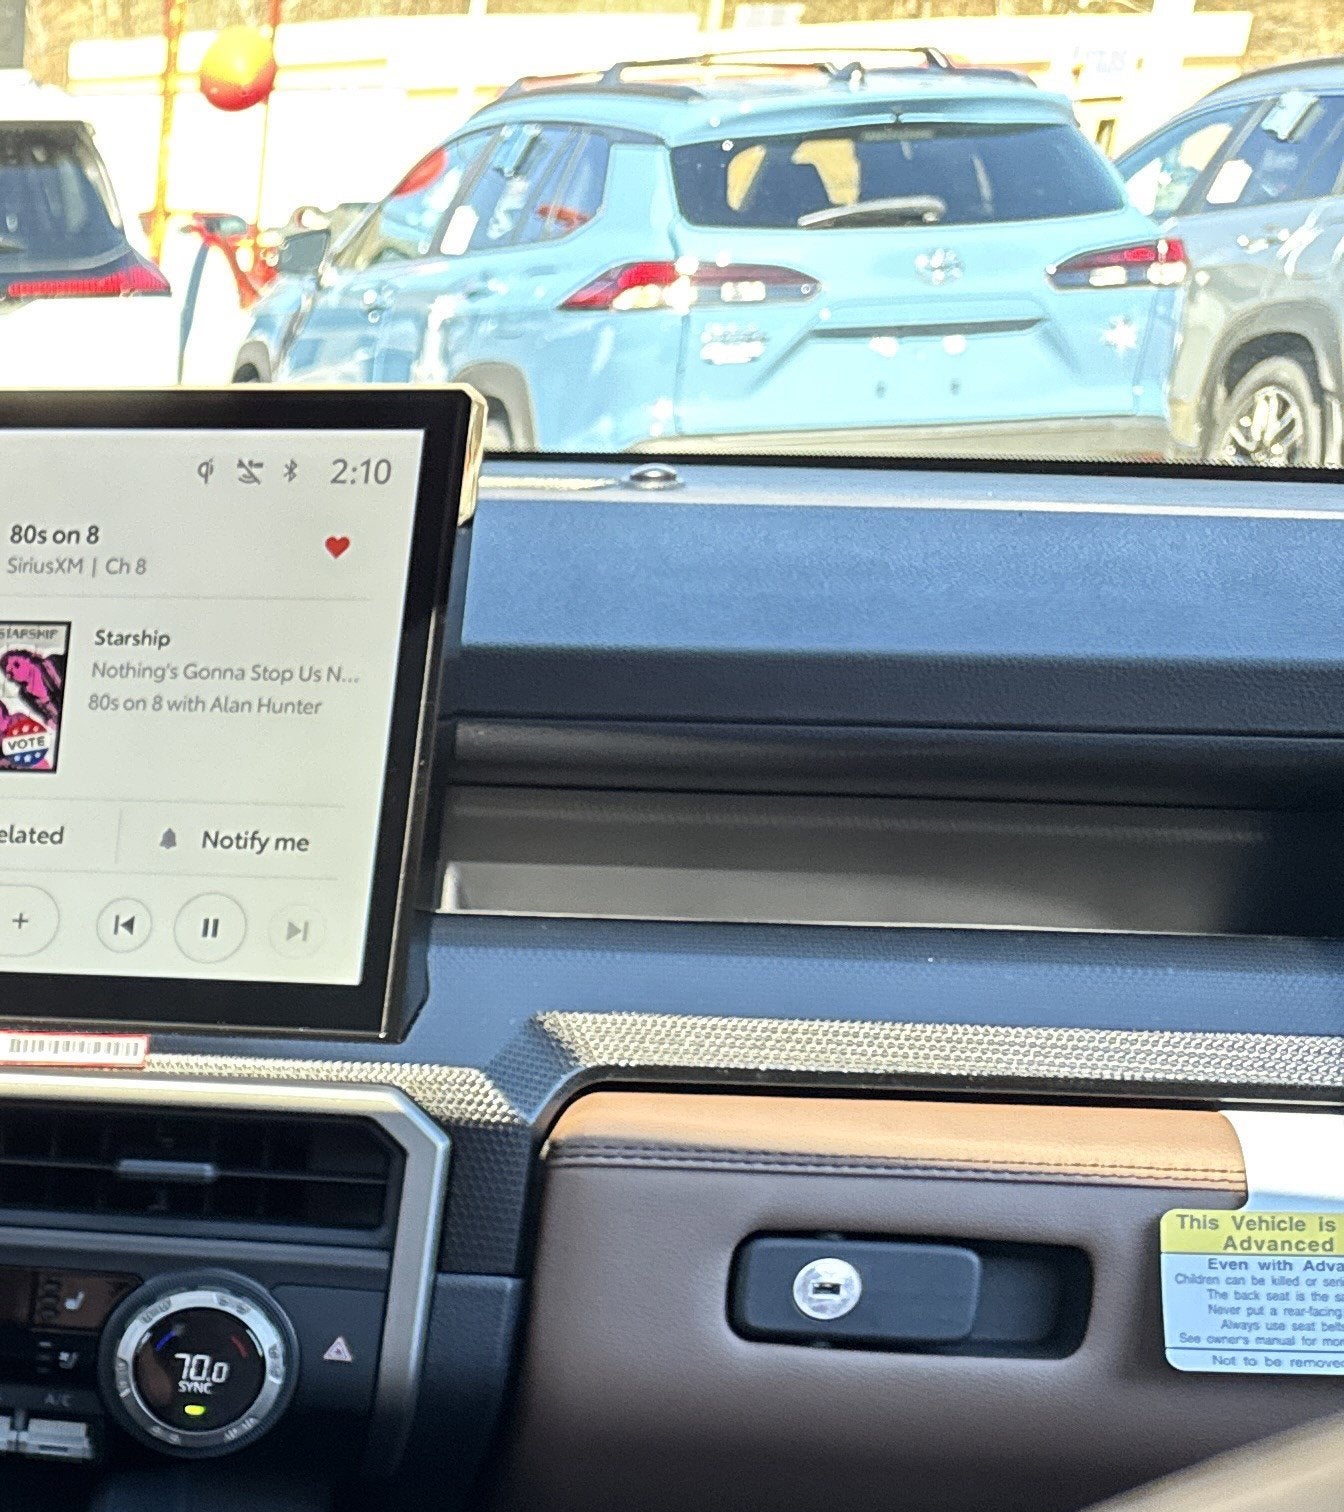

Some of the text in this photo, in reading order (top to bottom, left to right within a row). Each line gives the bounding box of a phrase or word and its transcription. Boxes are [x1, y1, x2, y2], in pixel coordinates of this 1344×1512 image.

[330, 458, 393, 485] 2:10
[10, 524, 100, 545] 80s on 8
[7, 556, 83, 575] SiriusXM
[105, 557, 130, 576] Ch
[135, 557, 147, 575] 8
[94, 629, 171, 651] Starship
[92, 661, 177, 684] Nothing's
[183, 663, 245, 682] Gonna
[250, 664, 294, 686] Stop
[298, 665, 323, 683] Us
[88, 696, 322, 716] 80s on 8 with Alan Hunter
[7, 735, 46, 751] VOTE
[201, 830, 310, 855] Notify me
[1176, 1213, 1337, 1232] This Vehicle is
[1222, 1235, 1335, 1253] Advanced
[1206, 1257, 1249, 1271] Even
[1257, 1259, 1293, 1272] with
[1174, 1272, 1220, 1286] Children
[1225, 1276, 1246, 1286] can
[1251, 1275, 1266, 1287] be
[1271, 1275, 1300, 1287] killed
[1305, 1278, 1317, 1287] or
[1206, 1288, 1228, 1300] The
[1234, 1289, 1260, 1301] back
[1266, 1291, 1290, 1301] seat
[1296, 1291, 1305, 1302] is
[1311, 1291, 1329, 1303] the
[1208, 1304, 1343, 1320] Never put a rear-facing
[1220, 1319, 1261, 1333] Always
[1265, 1322, 1286, 1332] use
[1292, 1322, 1316, 1332] seat
[1179, 1332, 1201, 1344] See
[1255, 1335, 1296, 1347] manual
[1301, 1336, 1317, 1347] for
[173, 1351, 230, 1384] 70.0
[1212, 1355, 1237, 1367] Not
[1243, 1356, 1258, 1367] to
[1264, 1356, 1282, 1368] be
[177, 1380, 213, 1396] SYNC
